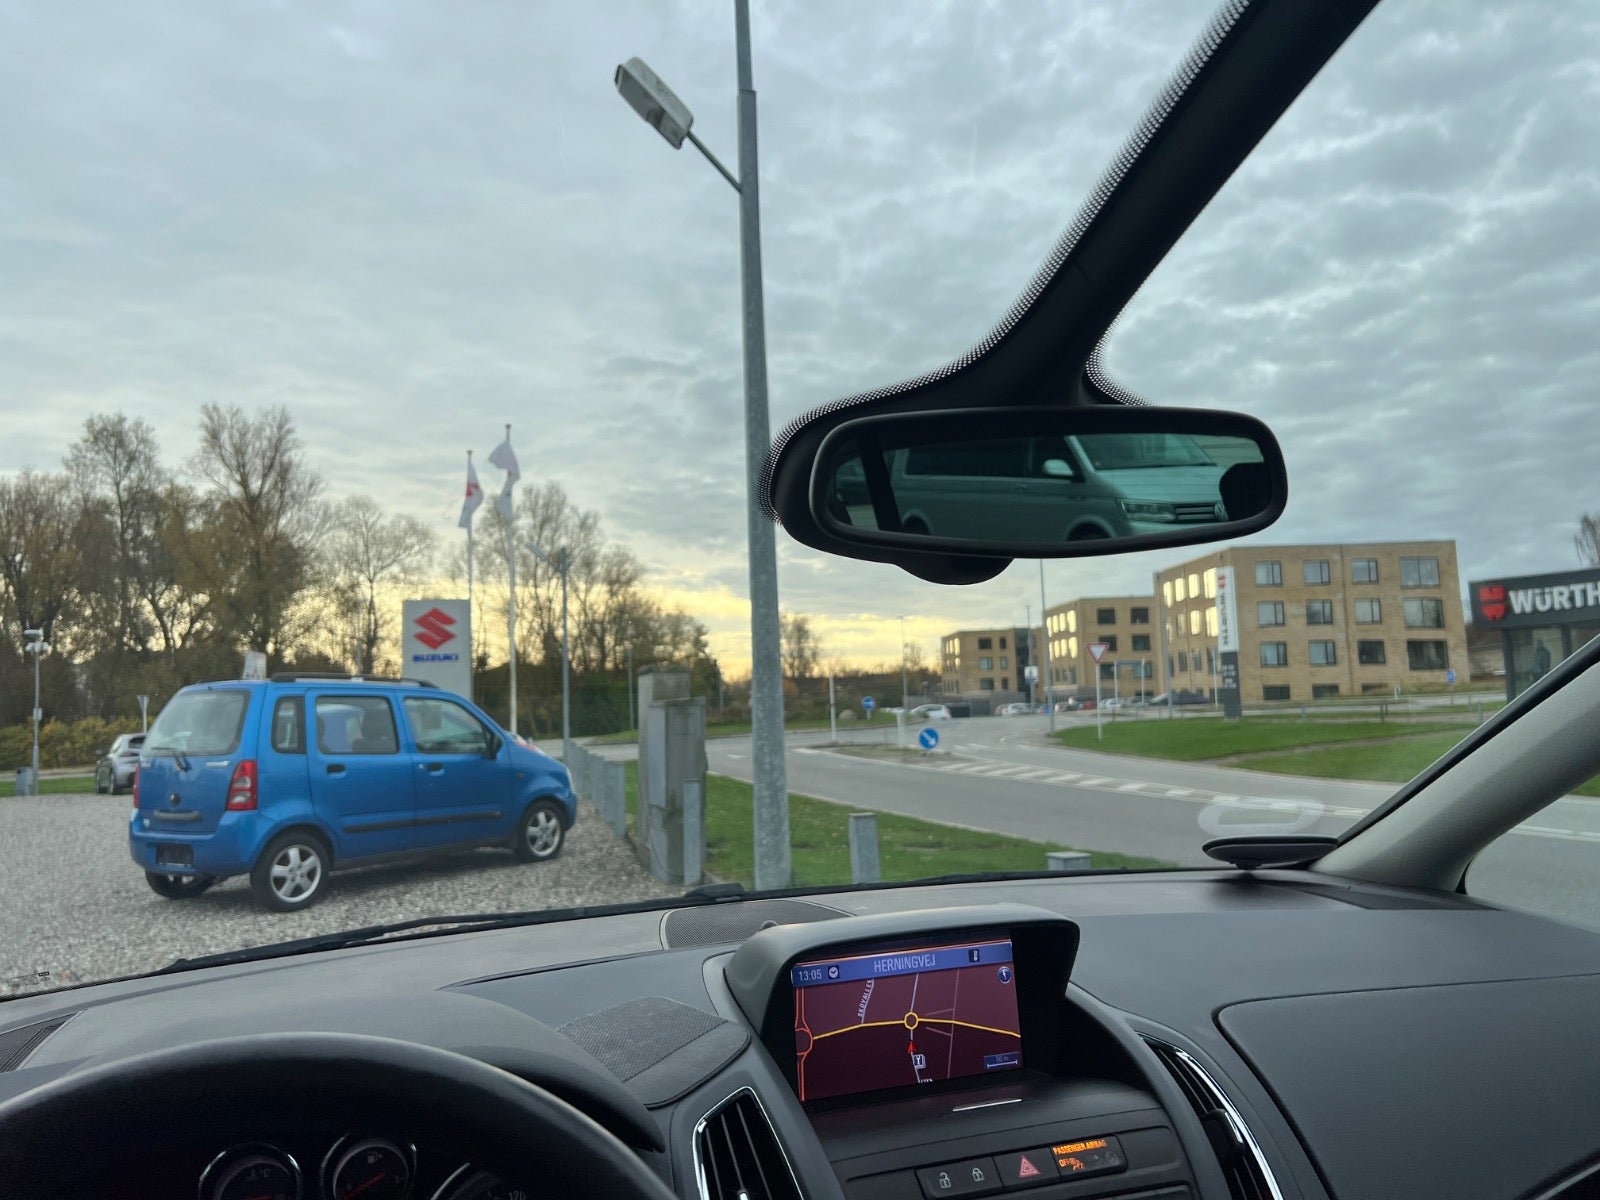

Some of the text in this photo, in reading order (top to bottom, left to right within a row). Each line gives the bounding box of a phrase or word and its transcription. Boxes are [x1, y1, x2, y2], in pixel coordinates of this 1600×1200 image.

[1509, 581, 1600, 614] WÜRTH
[413, 653, 458, 663] SUZUKI
[873, 954, 936, 973] HERNINGVEJ
[799, 969, 822, 982] 13:05
